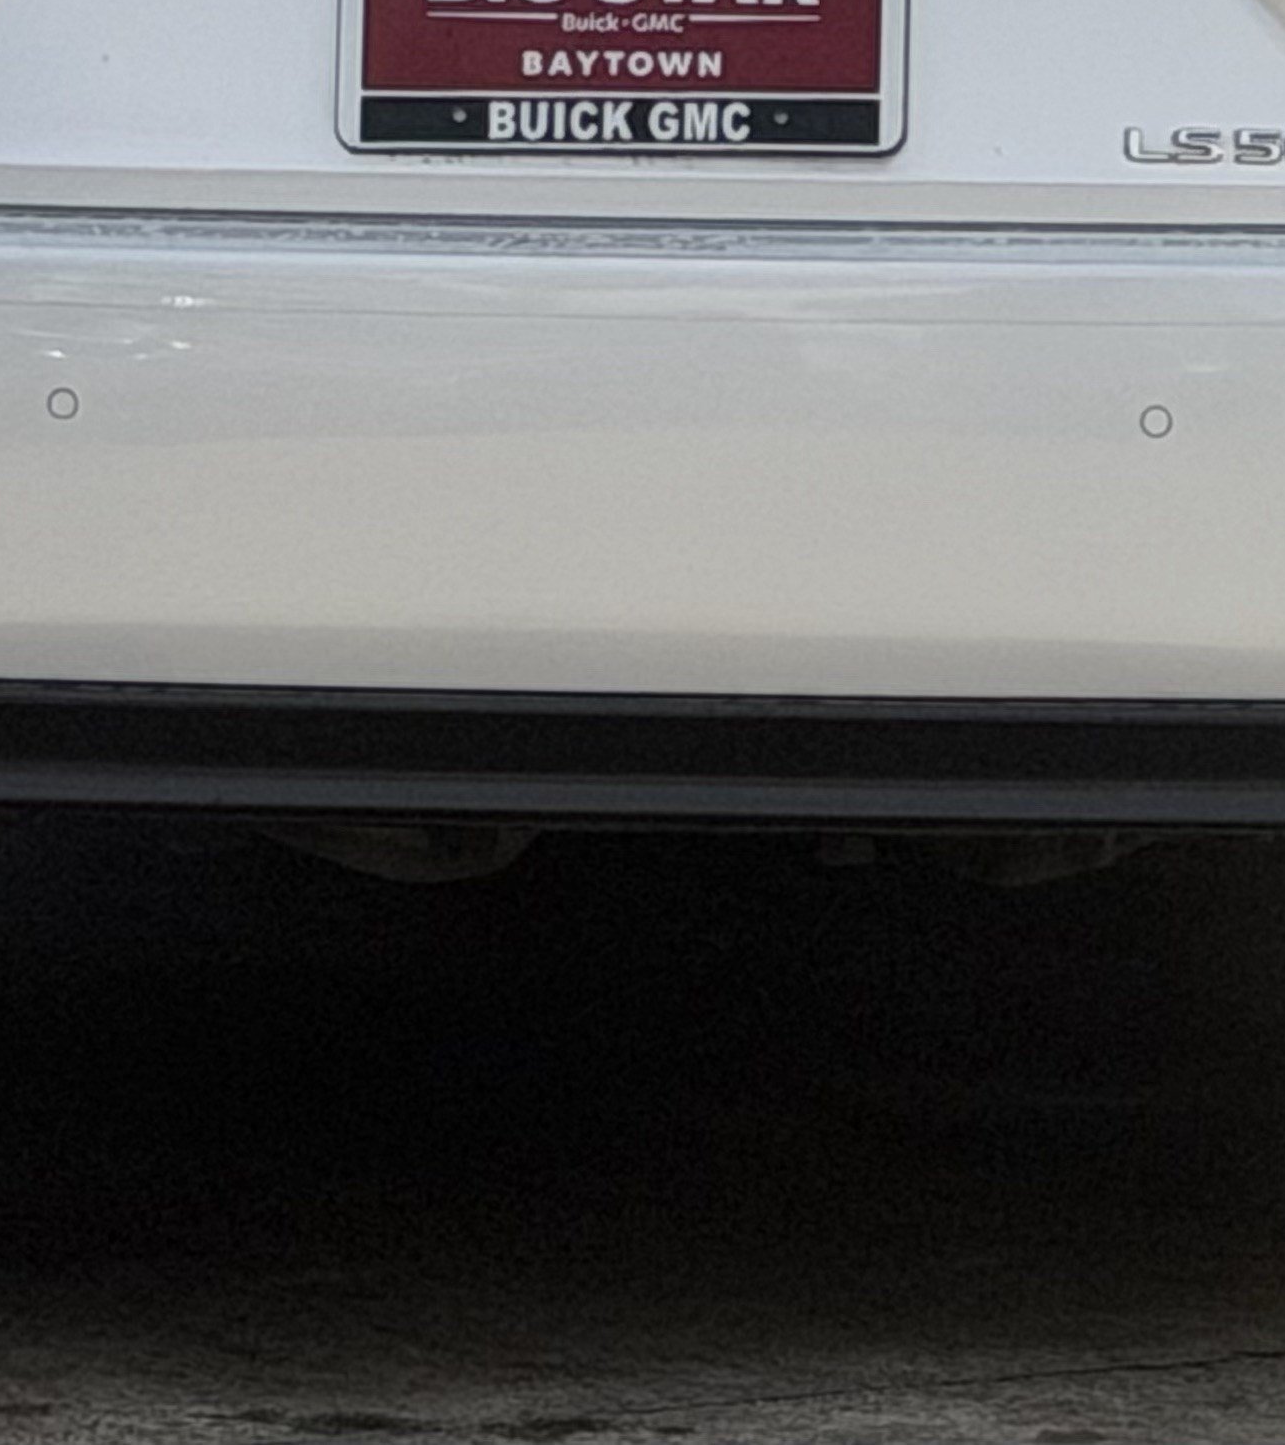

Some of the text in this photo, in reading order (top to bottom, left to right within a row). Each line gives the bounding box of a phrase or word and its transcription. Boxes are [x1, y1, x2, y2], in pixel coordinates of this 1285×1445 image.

[561, 12, 685, 33] Buick GMC
[521, 50, 722, 77] BAYTOWN
[487, 101, 751, 141] BUICK GMC
[1123, 126, 1225, 164] LS
